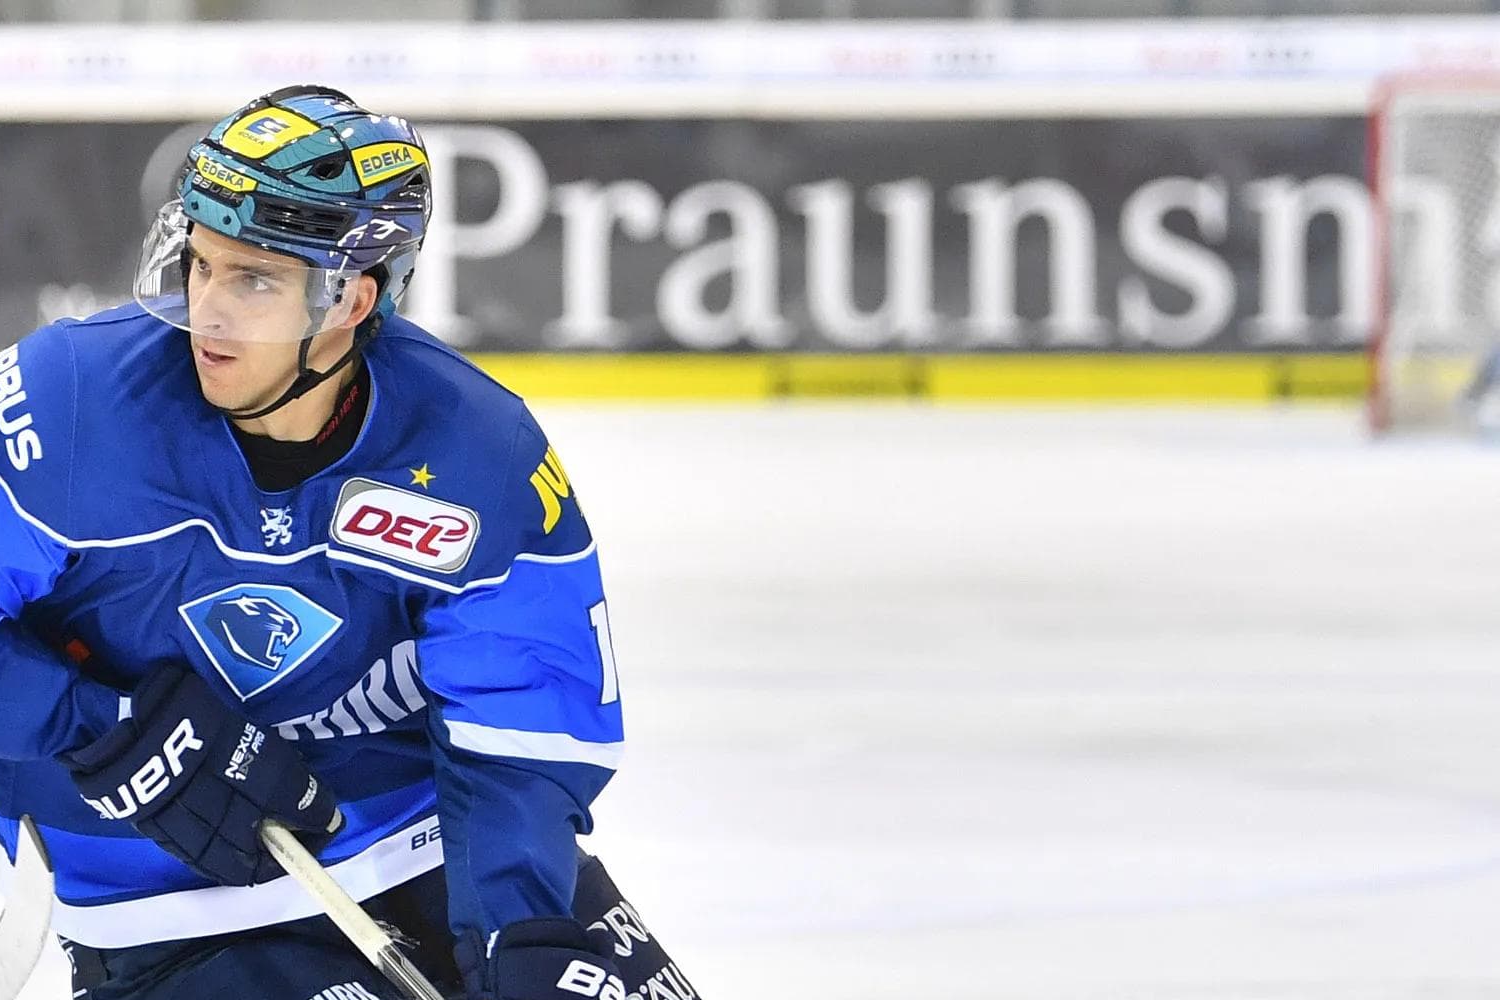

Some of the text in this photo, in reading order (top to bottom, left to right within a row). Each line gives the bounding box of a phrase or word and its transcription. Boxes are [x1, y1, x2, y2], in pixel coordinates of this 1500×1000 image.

[200, 157, 245, 189] EDEKA
[360, 146, 412, 174] EDEKA
[394, 122, 1500, 352] Praunsm
[224, 721, 257, 778] NEXUS
[251, 730, 266, 755] PRO
